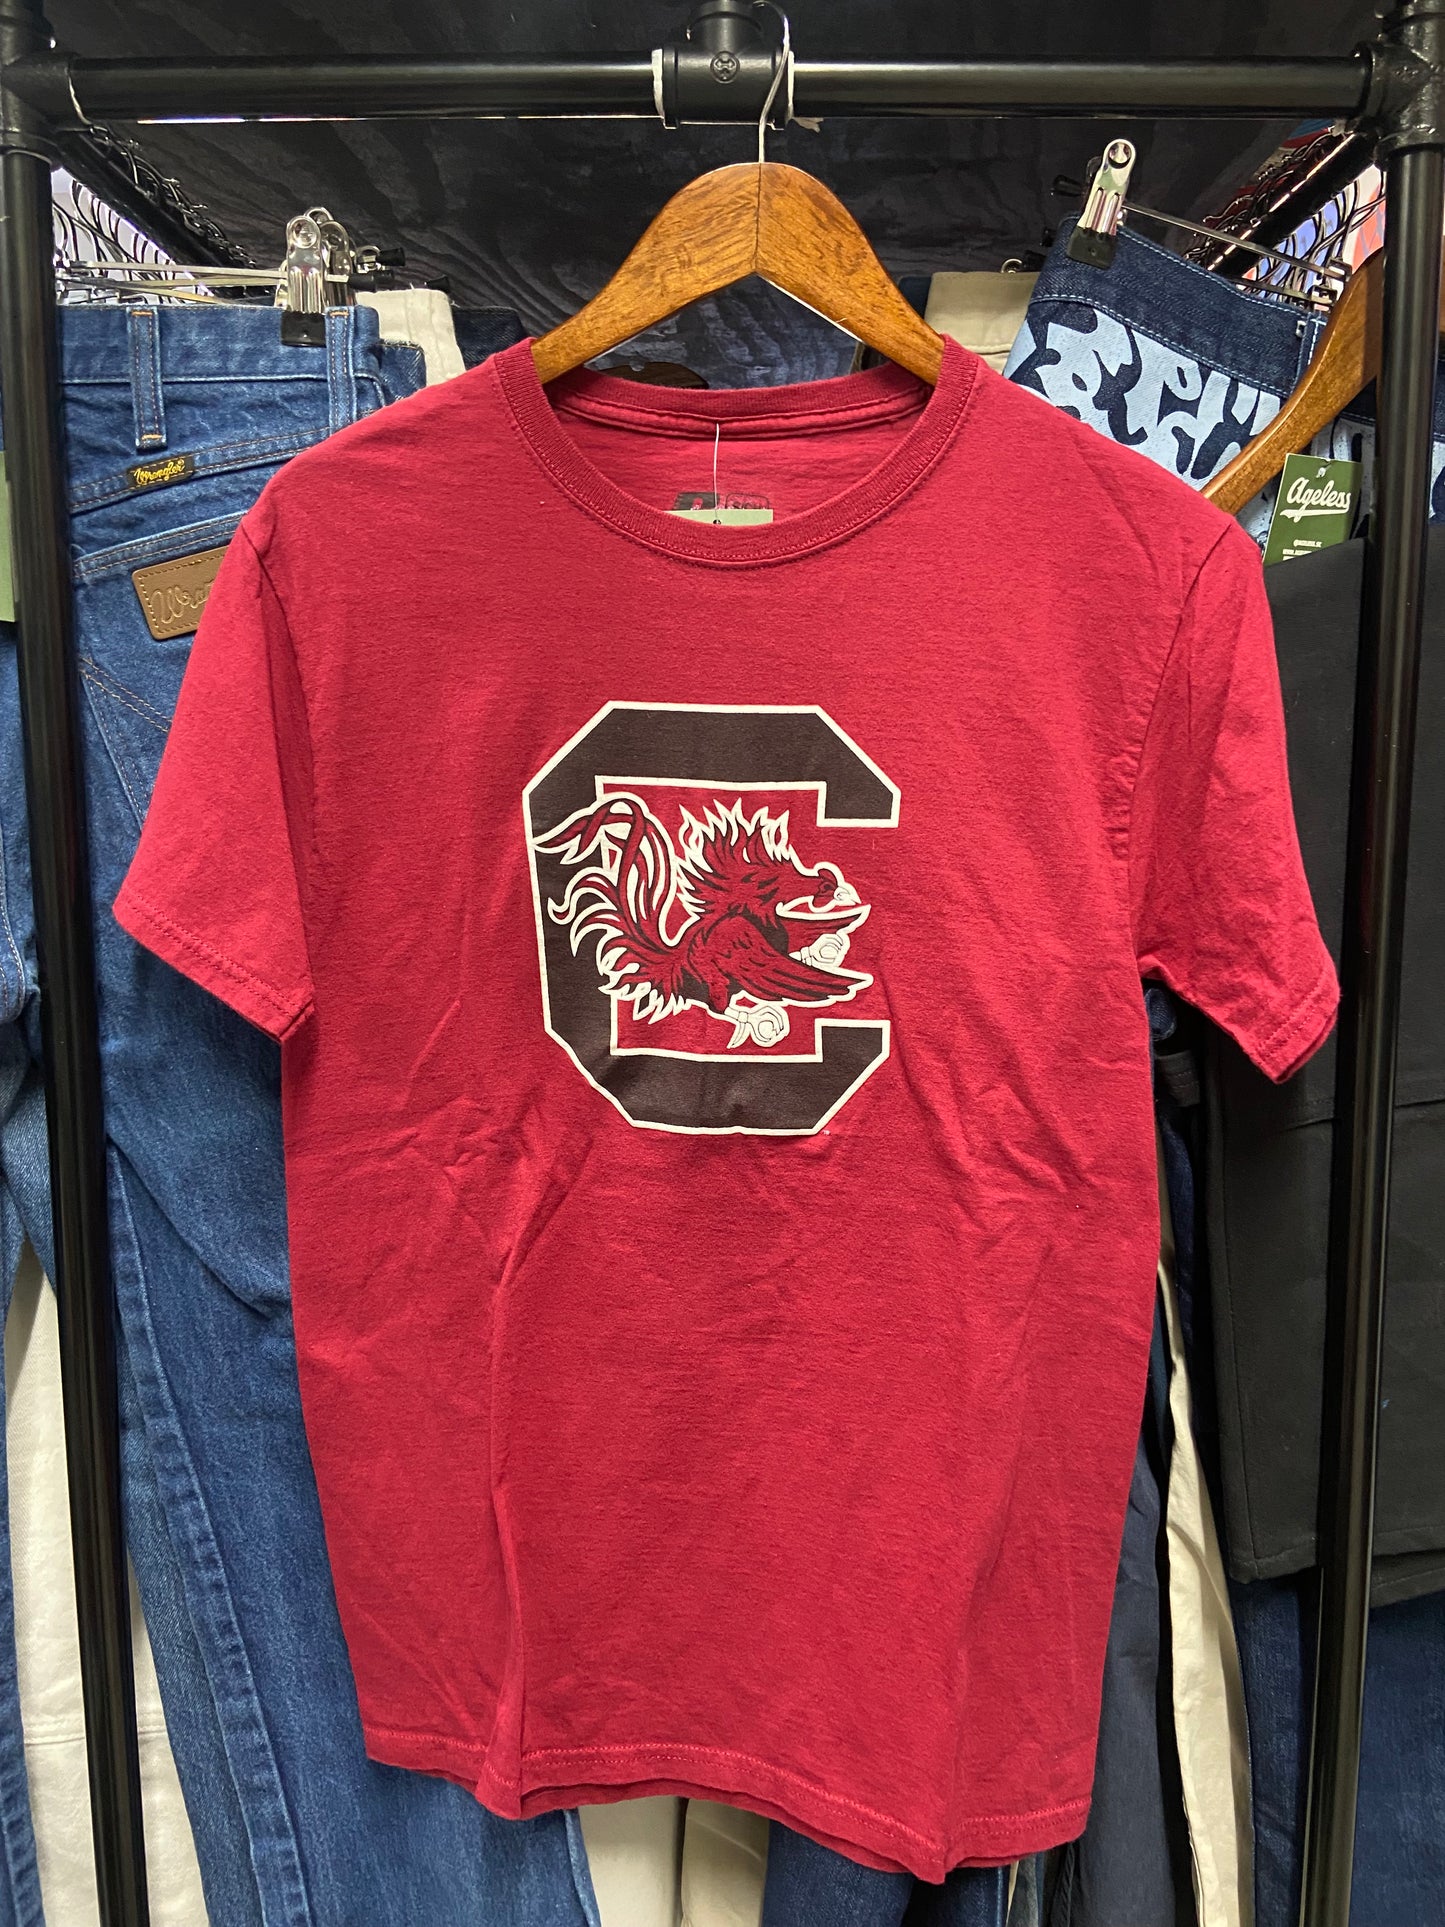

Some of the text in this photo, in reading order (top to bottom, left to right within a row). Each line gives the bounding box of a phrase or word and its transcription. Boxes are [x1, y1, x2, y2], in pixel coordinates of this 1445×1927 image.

[134, 459, 185, 485] Wrangler
[1284, 477, 1351, 522] Ageless
[522, 700, 901, 1136] C
